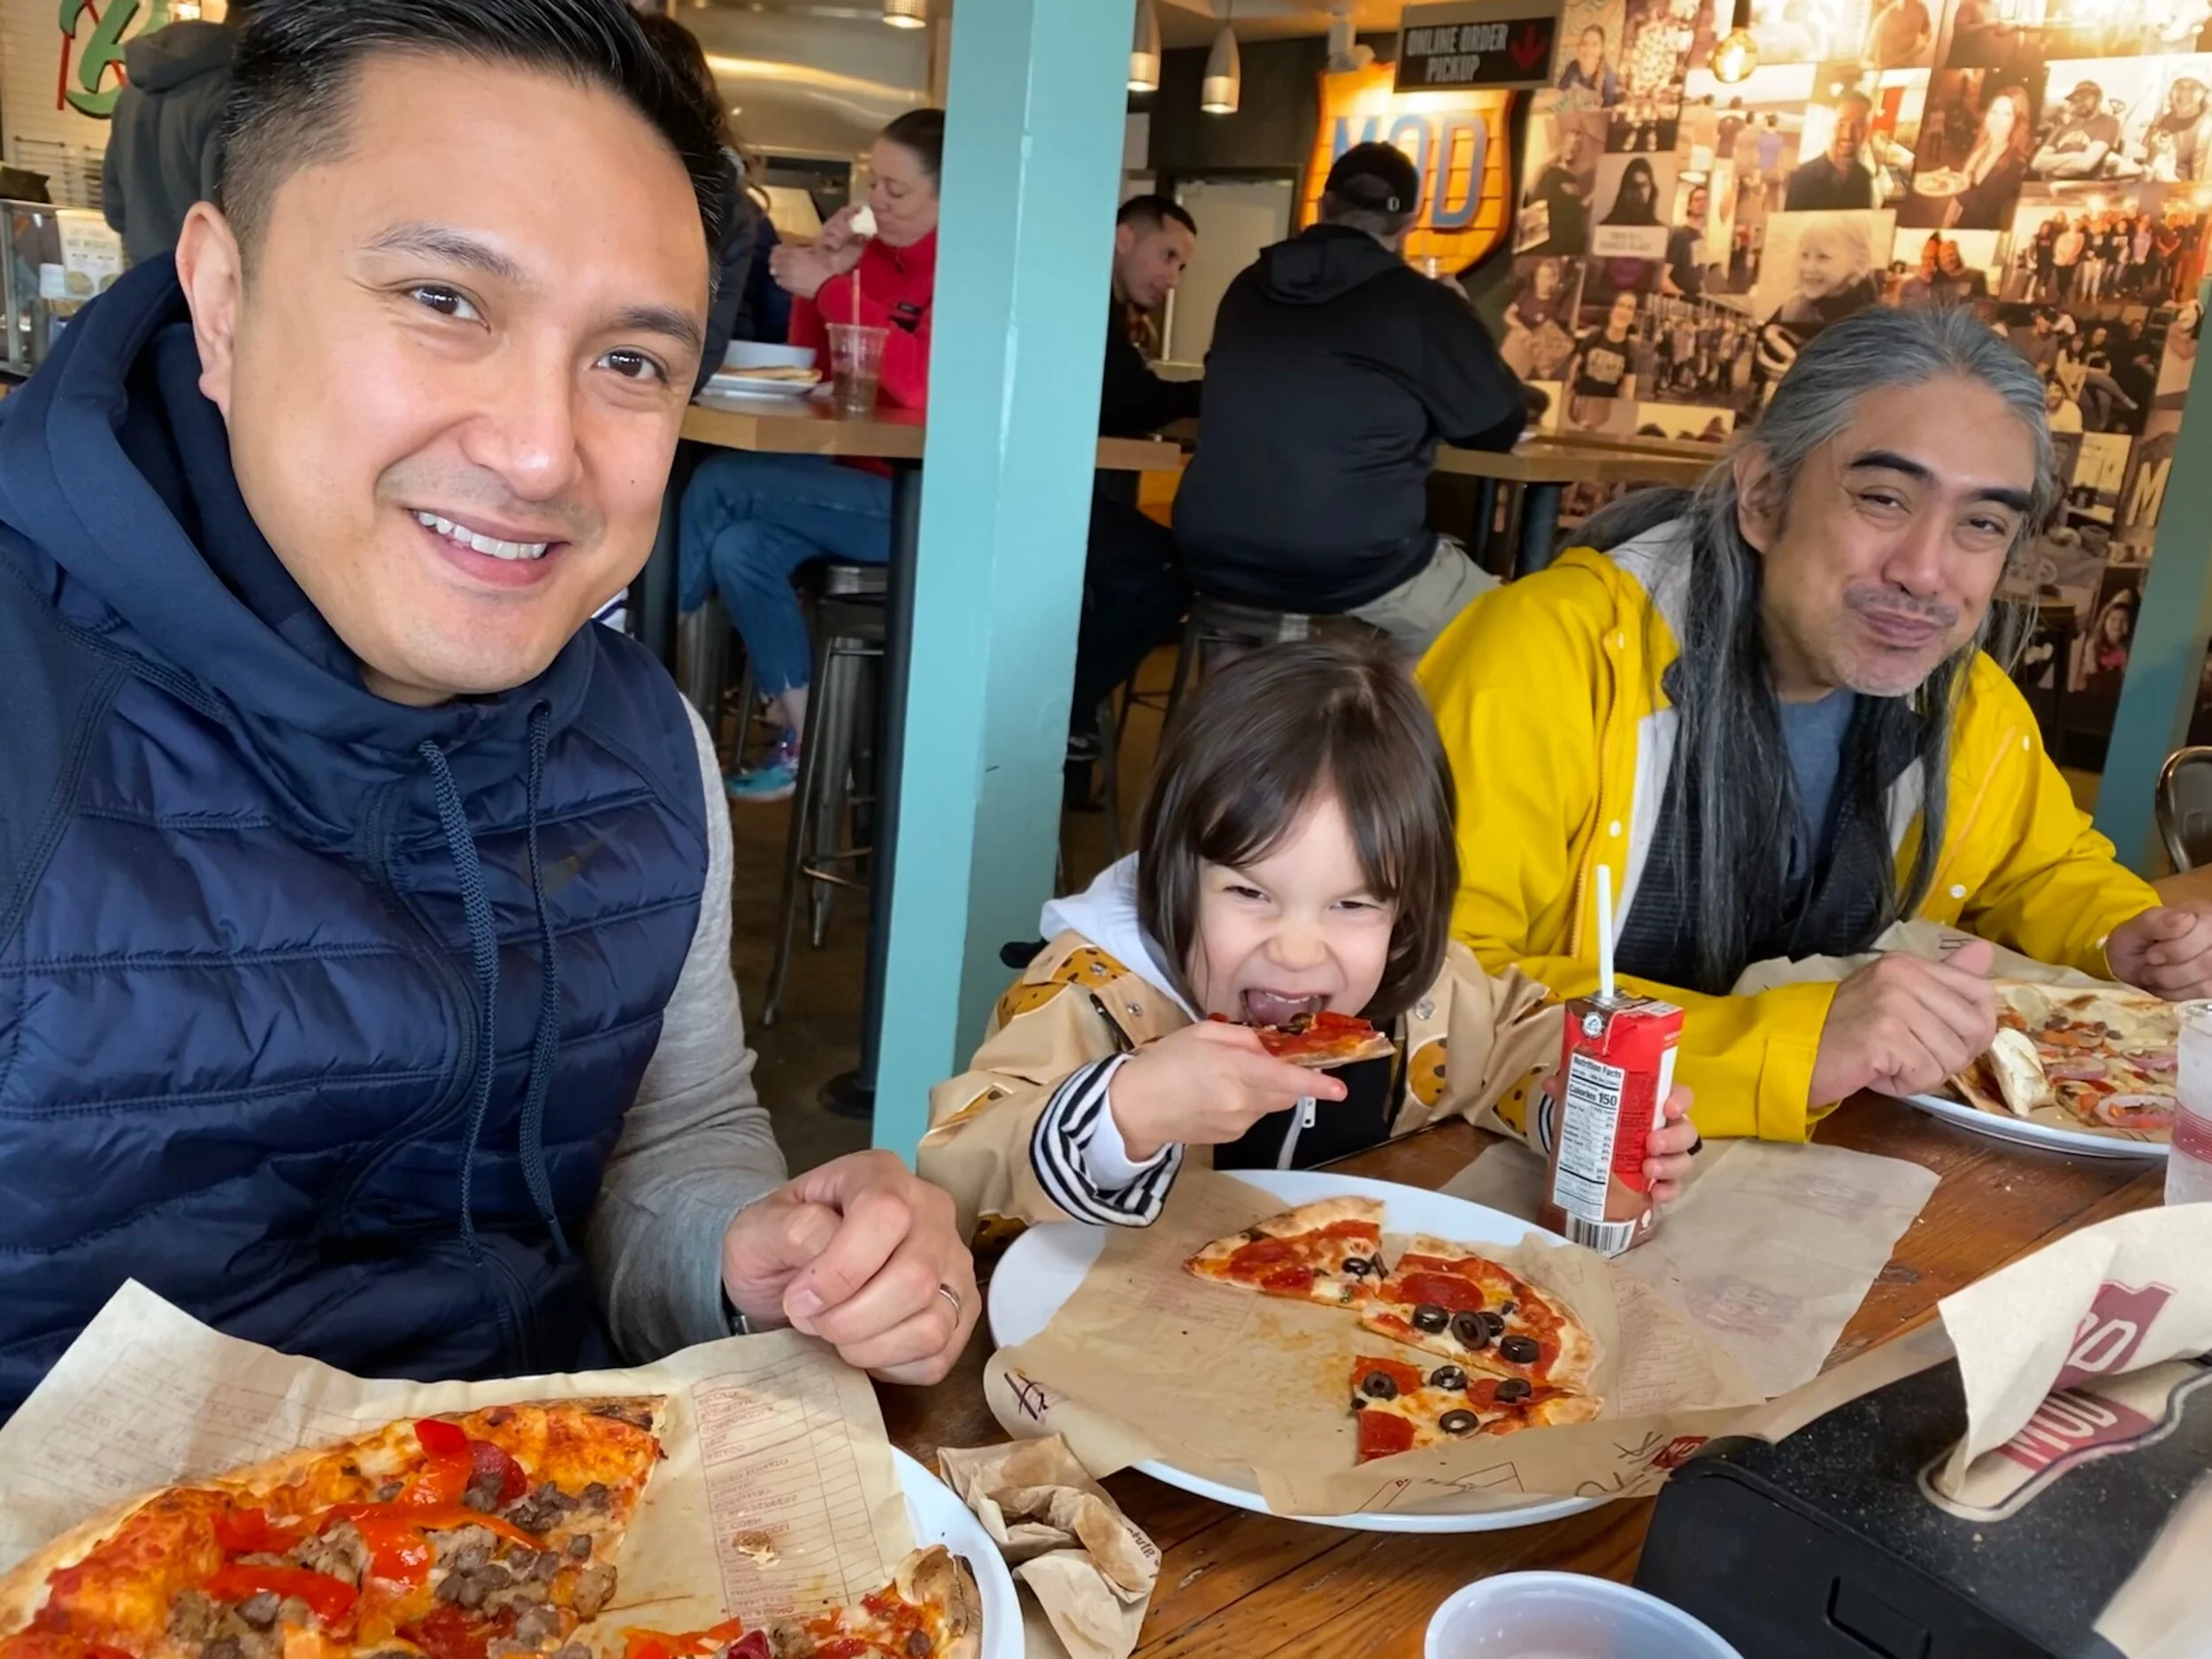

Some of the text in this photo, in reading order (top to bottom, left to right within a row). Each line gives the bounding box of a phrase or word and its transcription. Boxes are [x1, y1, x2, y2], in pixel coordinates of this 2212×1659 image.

[1407, 24, 1509, 57] ONLINE ORDER
[1425, 55, 1480, 82] PICKUP
[1602, 1066, 1622, 1079] Facts
[1569, 1084, 1617, 1107] Calories 150
